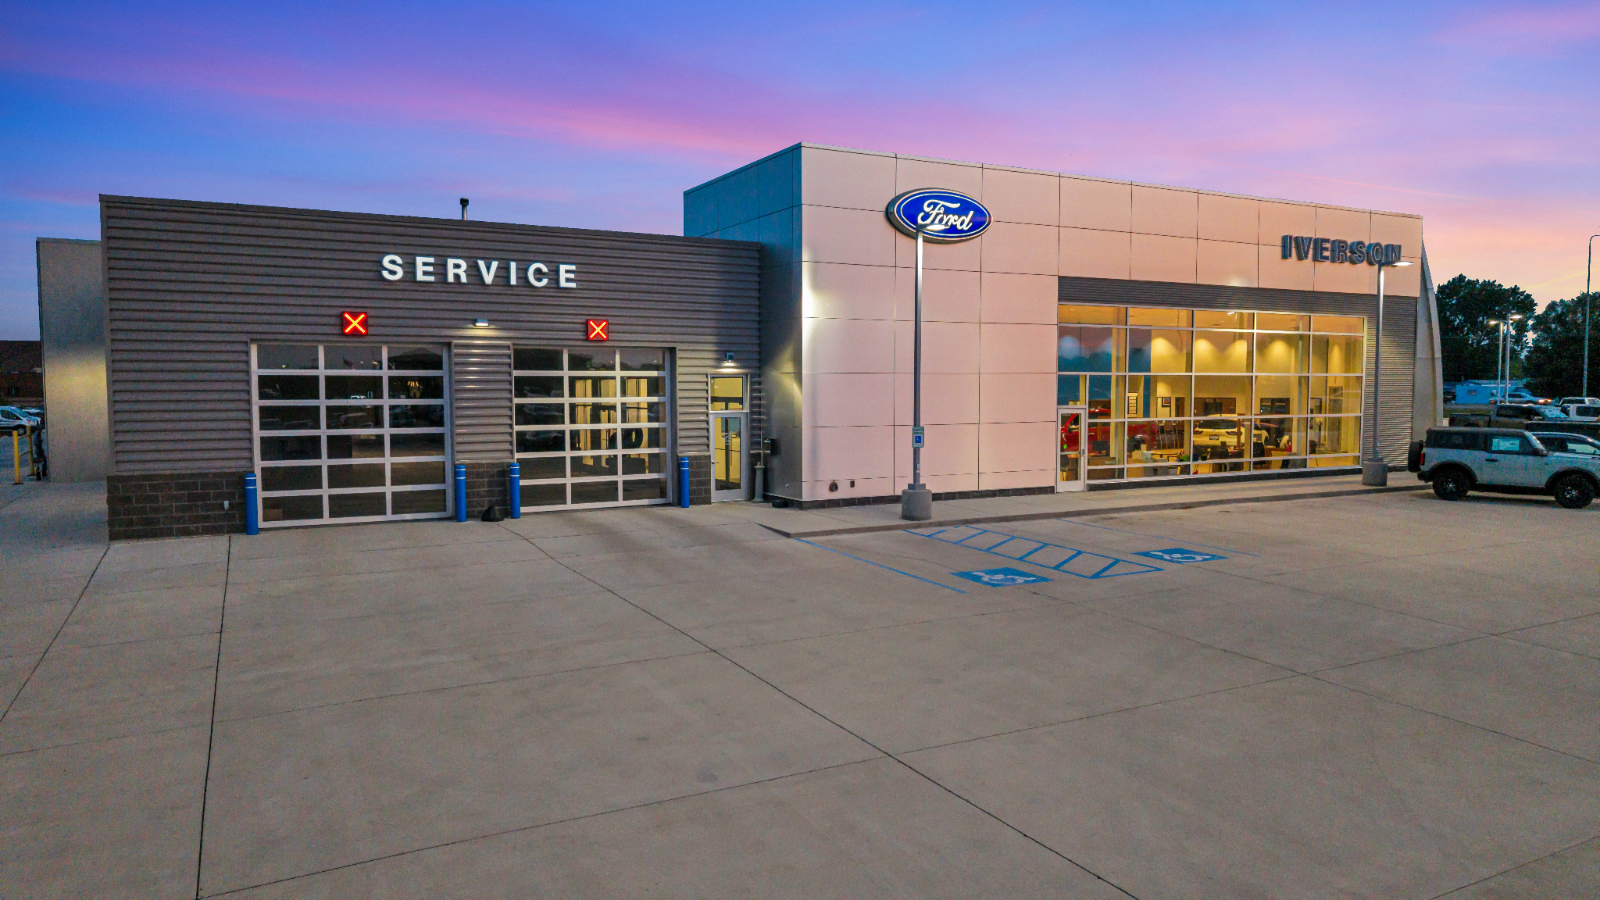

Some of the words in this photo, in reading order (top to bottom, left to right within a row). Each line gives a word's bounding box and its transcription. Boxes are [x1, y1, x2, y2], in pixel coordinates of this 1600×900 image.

[917, 199, 974, 230] Ford
[1281, 234, 1402, 266] IVERSON
[381, 253, 577, 288] SERVICE
